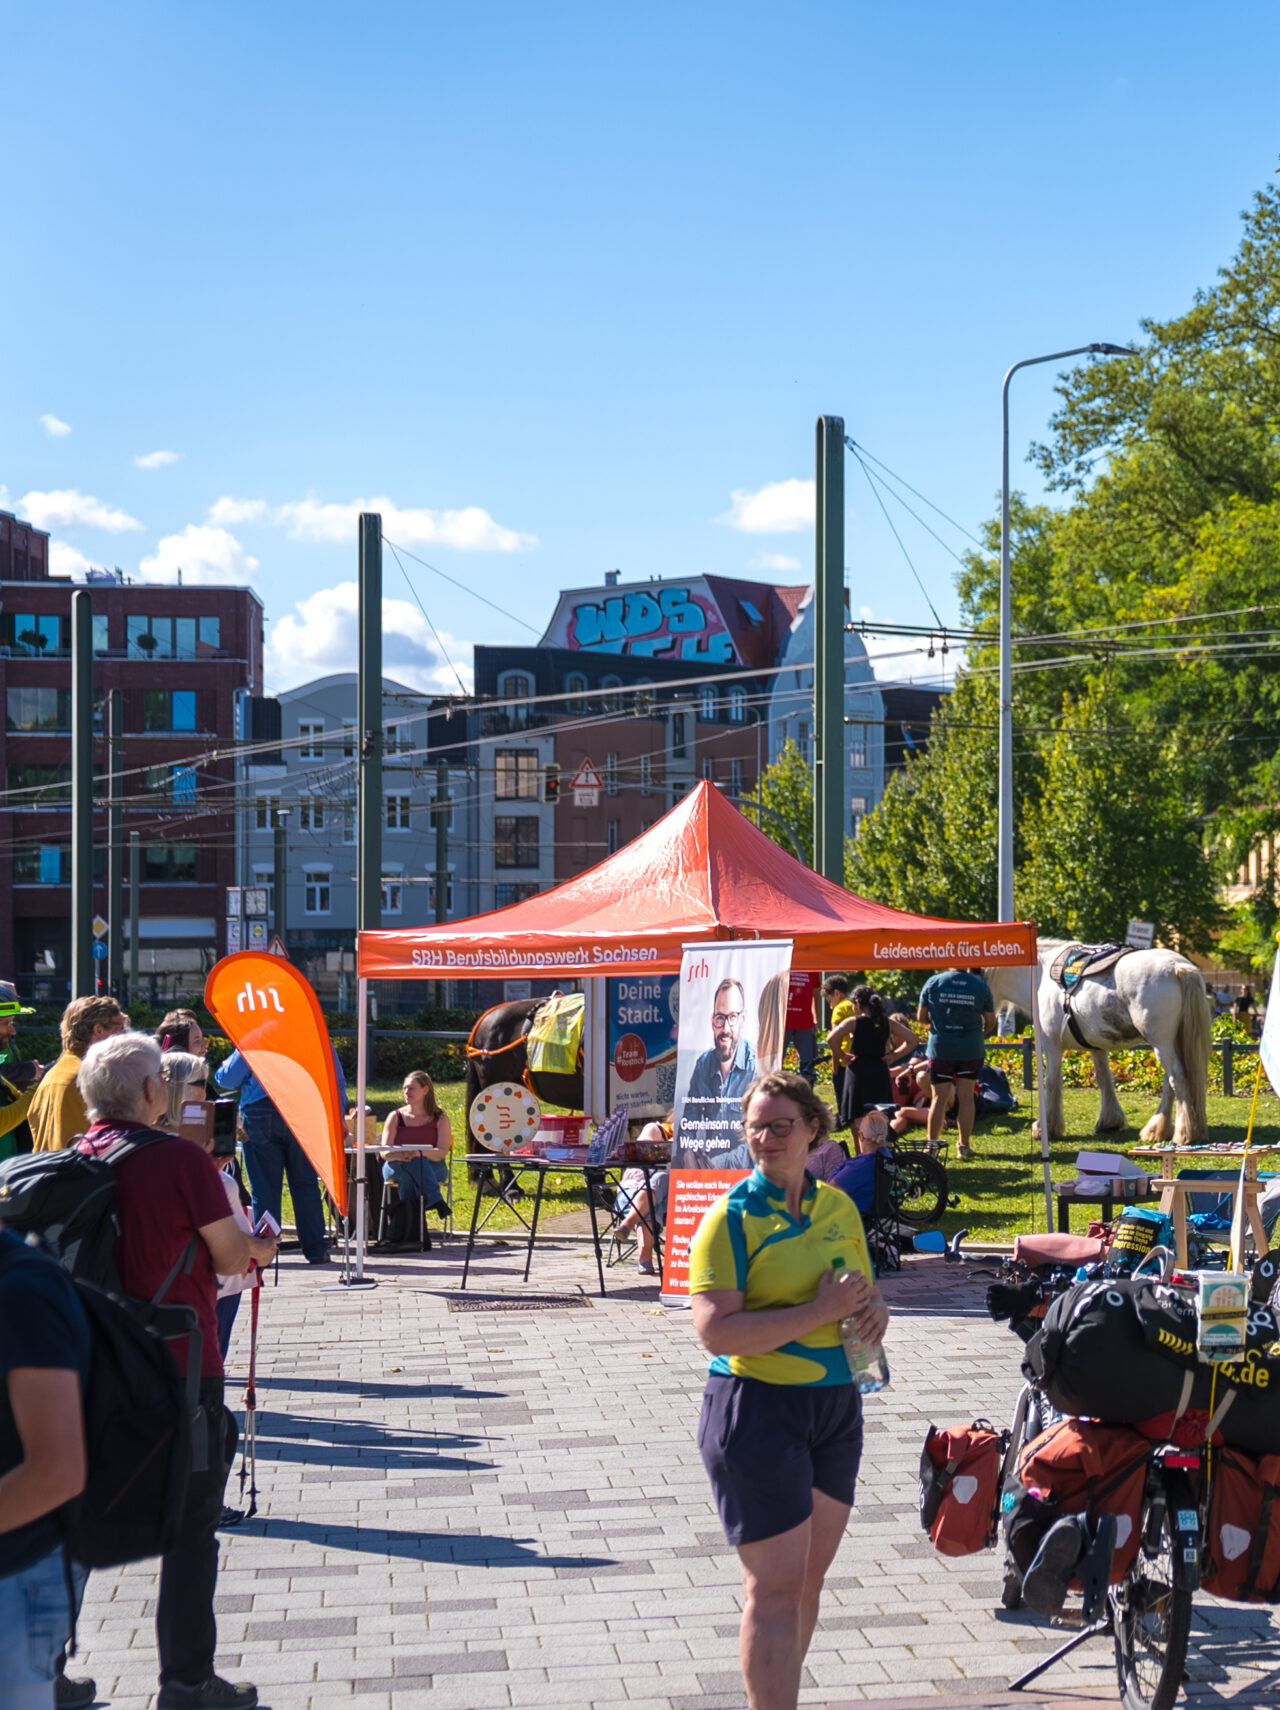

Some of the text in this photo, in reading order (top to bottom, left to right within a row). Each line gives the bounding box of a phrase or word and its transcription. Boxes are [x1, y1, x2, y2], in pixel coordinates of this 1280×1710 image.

[573, 587, 707, 646] WDS
[411, 945, 658, 966] SRH Berufsbildungswerk Sachsen
[873, 940, 1025, 959] Leidenschaft fürs Leben.
[618, 980, 662, 1000] Deine
[618, 1004, 663, 1025] Stadt.
[680, 1117, 744, 1131] Gemeinsam ne
[680, 1135, 731, 1152] Wege gehen
